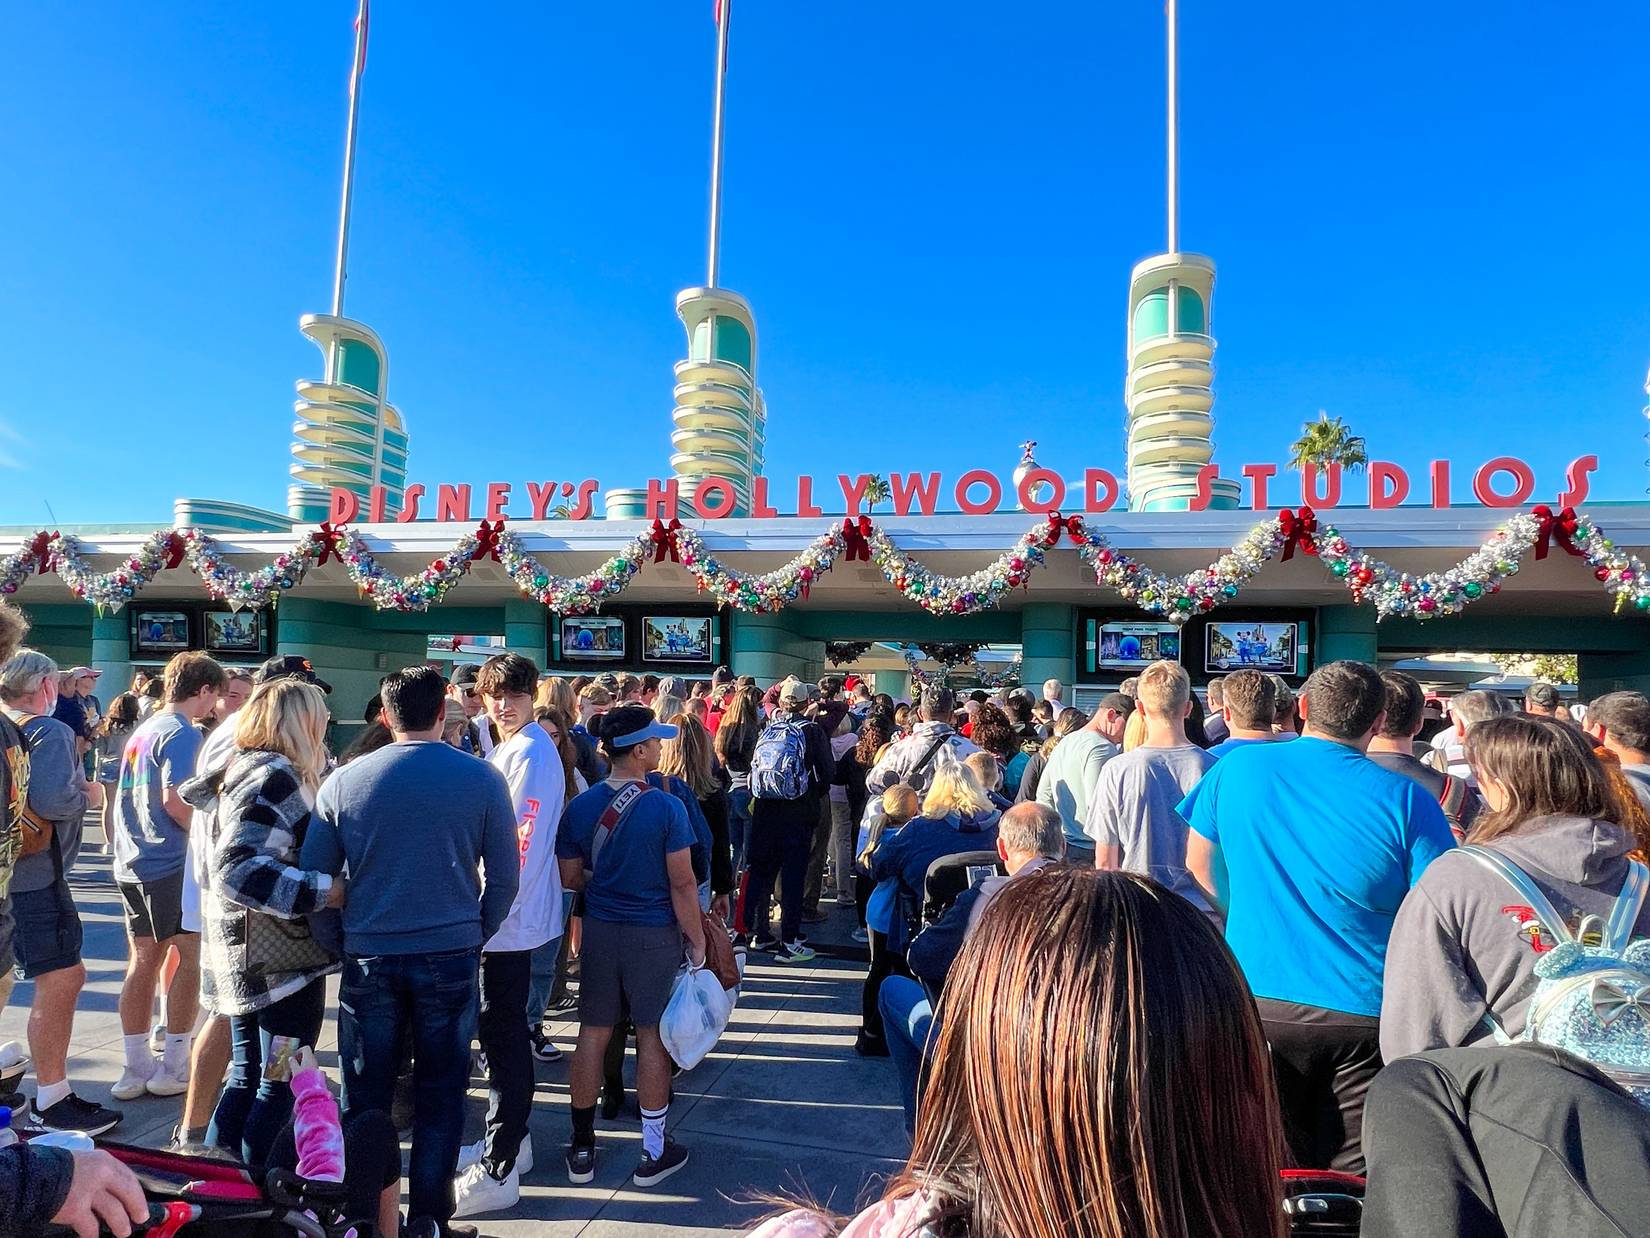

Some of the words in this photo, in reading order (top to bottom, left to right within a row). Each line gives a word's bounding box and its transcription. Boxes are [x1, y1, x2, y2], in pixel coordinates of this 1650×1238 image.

[329, 479, 600, 525] DISNEY'S
[646, 468, 1119, 519] HOLLYWOOD
[1188, 454, 1598, 512] STUDIOS
[615, 788, 639, 809] YETI
